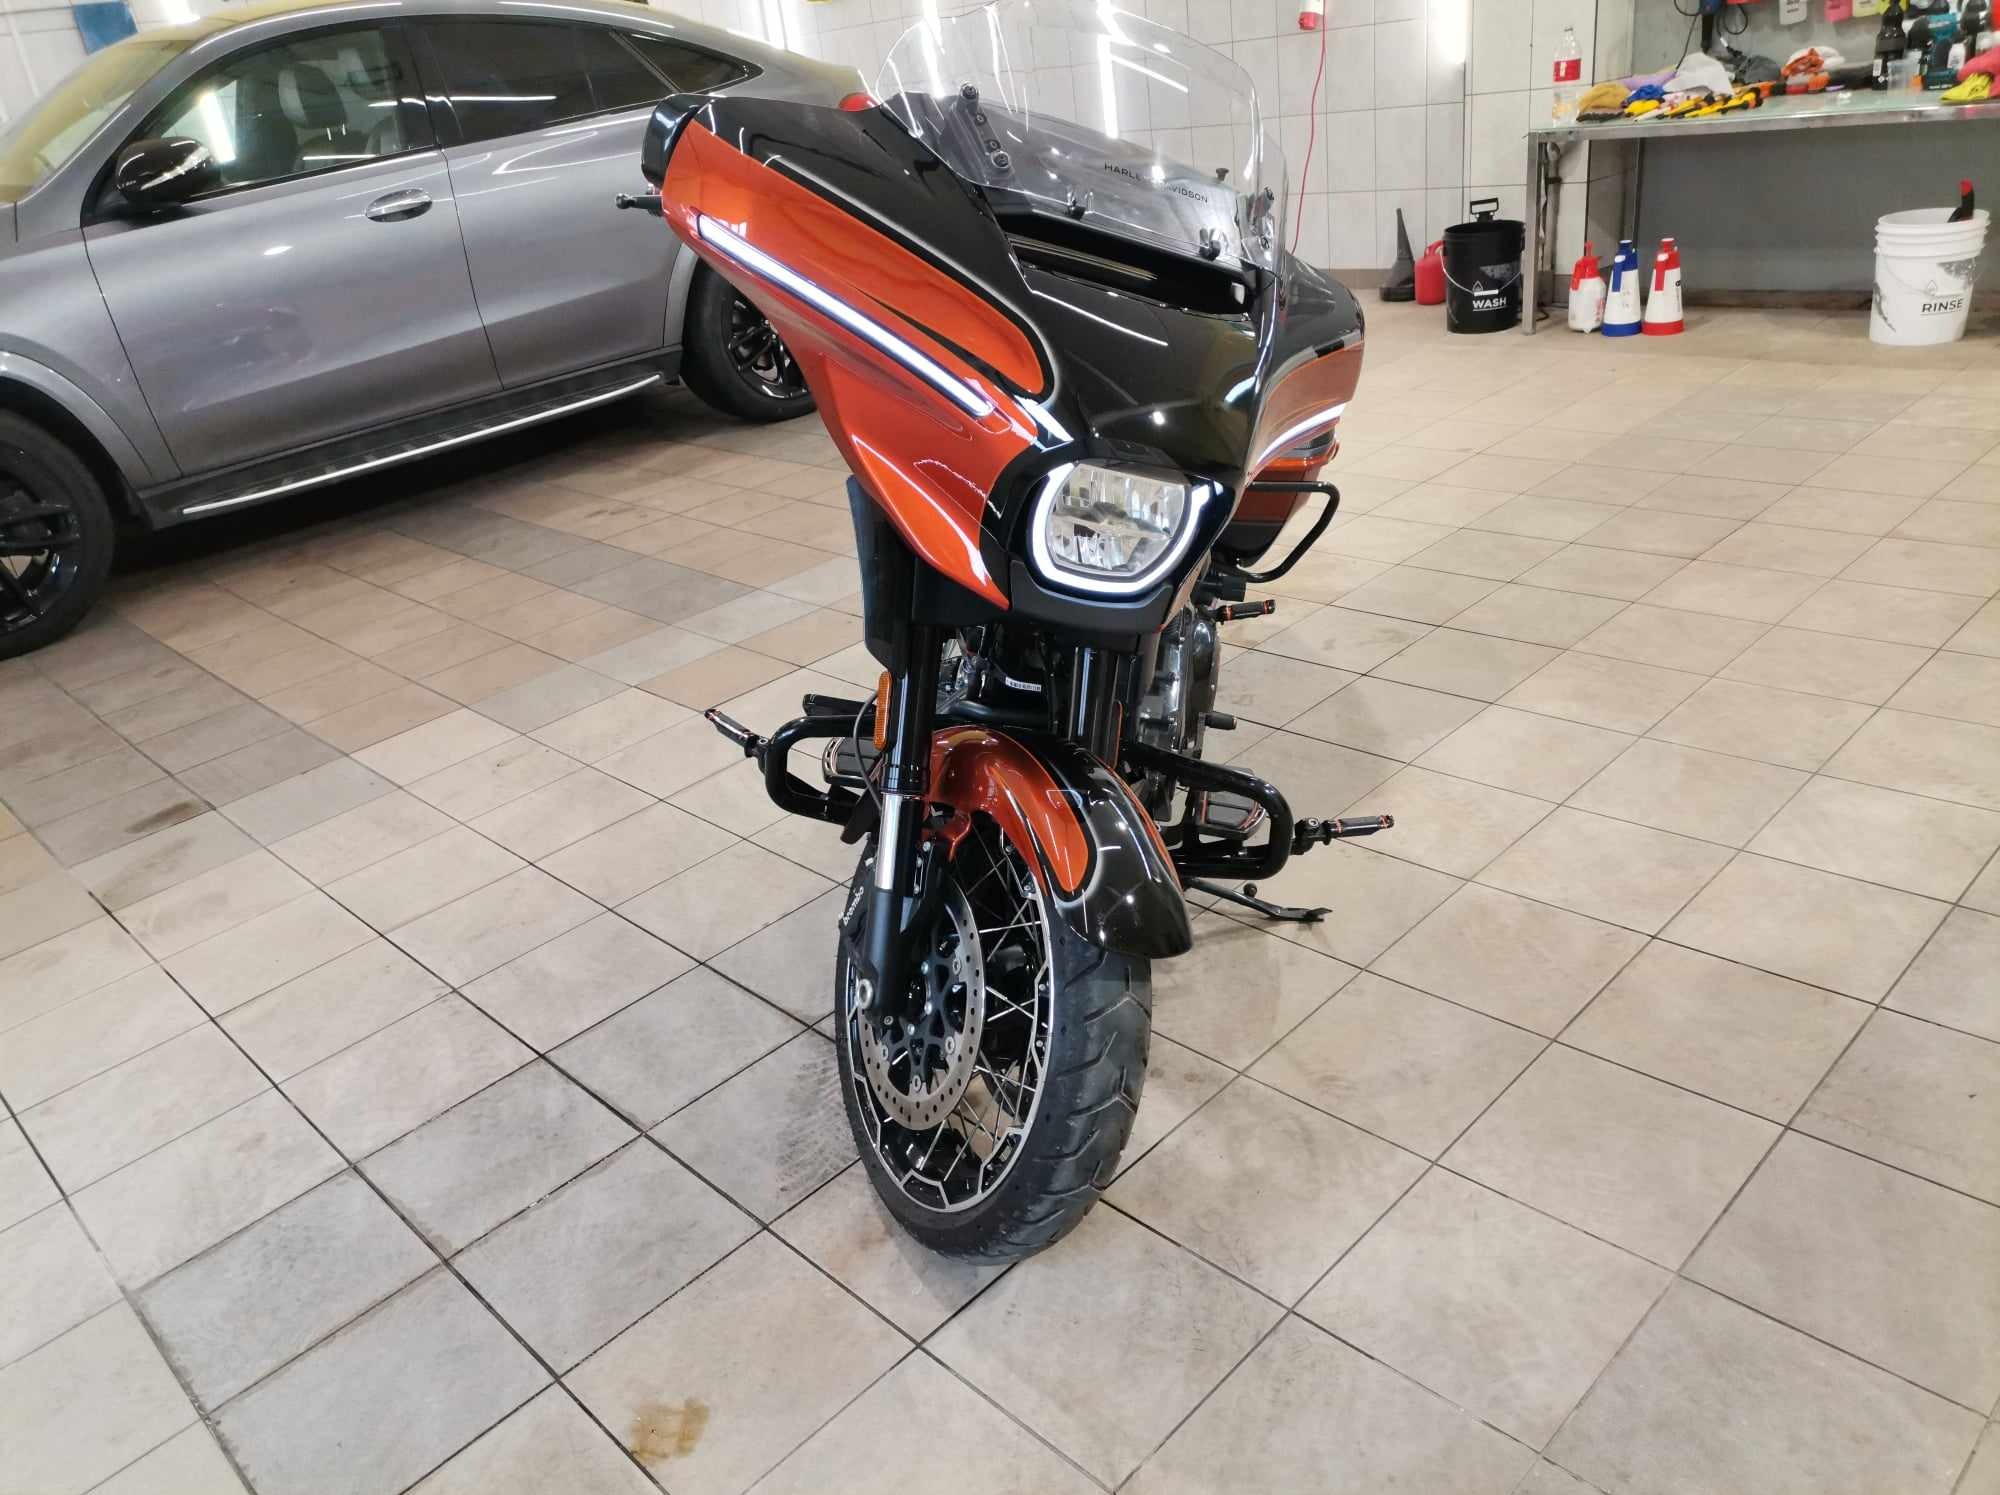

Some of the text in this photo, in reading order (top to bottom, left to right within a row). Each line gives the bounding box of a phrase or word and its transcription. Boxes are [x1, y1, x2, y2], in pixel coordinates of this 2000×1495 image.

[1104, 161, 1208, 203] HARLAVIDSON
[1472, 297, 1507, 309] WASH
[1921, 298, 1964, 312] RINSE
[843, 886, 864, 927] brembo
